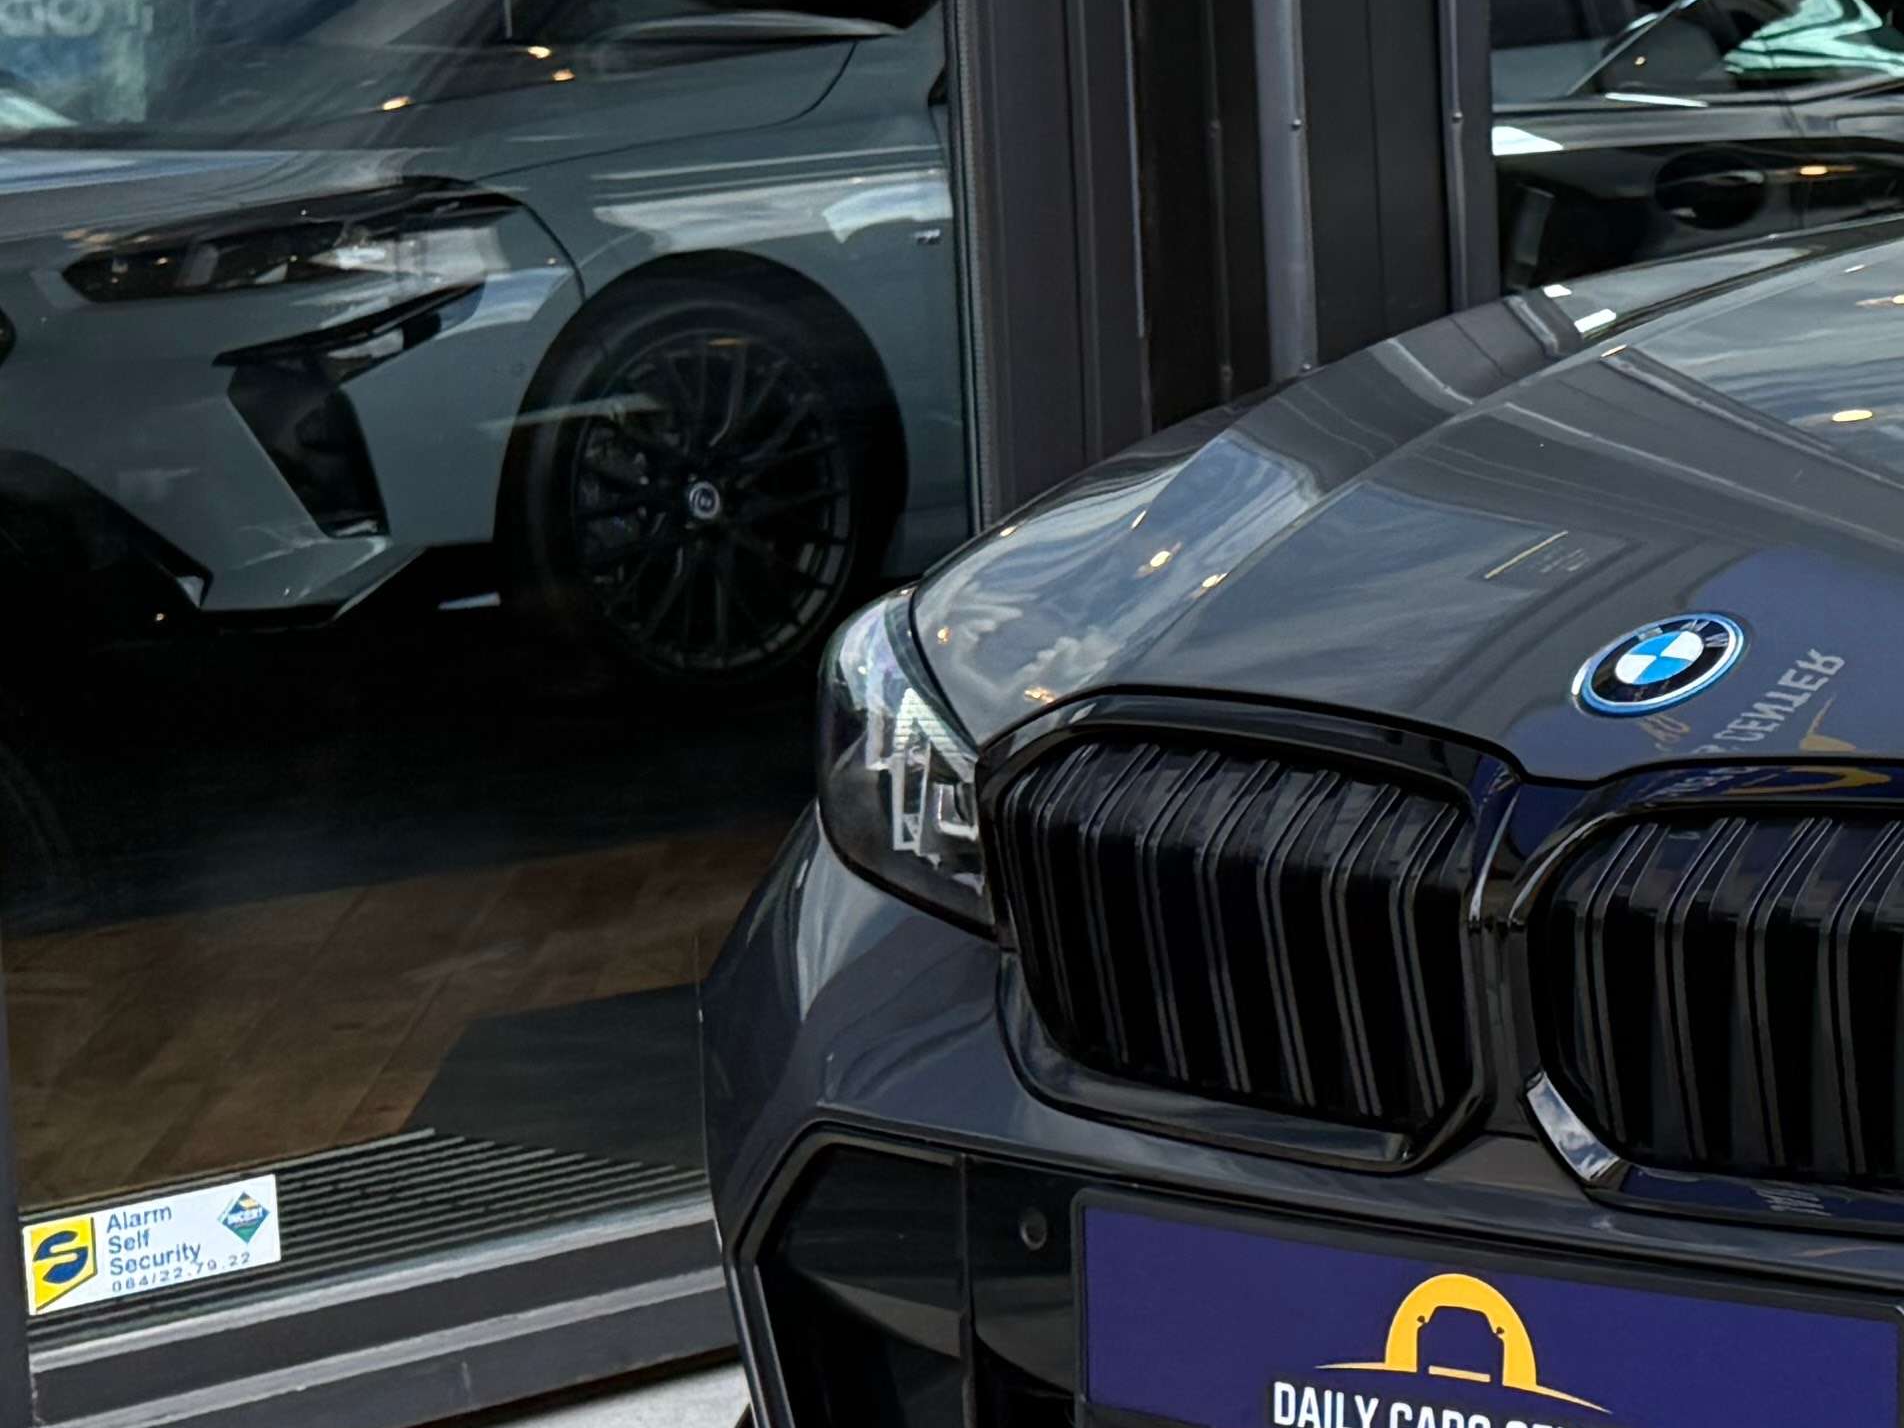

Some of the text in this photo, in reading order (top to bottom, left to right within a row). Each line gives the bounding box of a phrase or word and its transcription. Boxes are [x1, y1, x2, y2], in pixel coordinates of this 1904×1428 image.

[106, 1206, 173, 1234] Alarm
[108, 1228, 151, 1255] Self
[109, 1243, 202, 1276] Security
